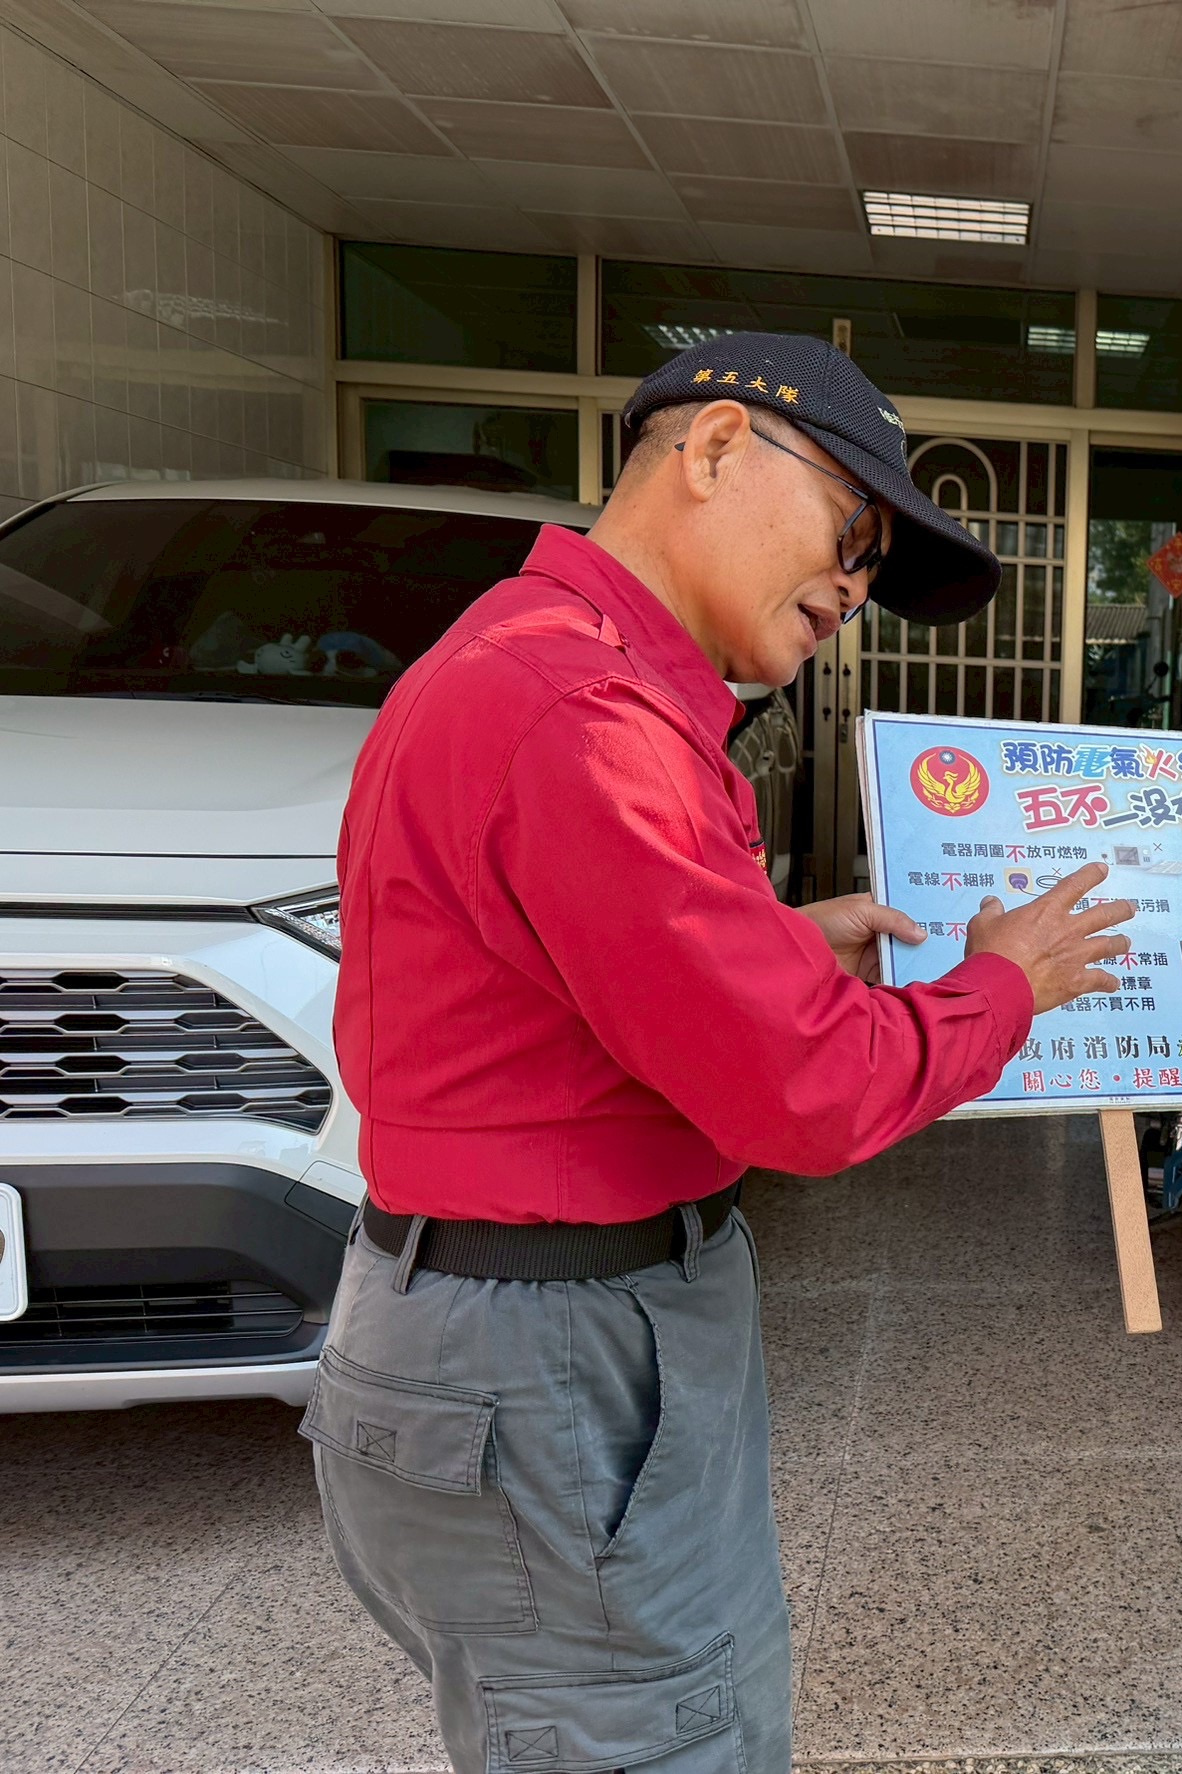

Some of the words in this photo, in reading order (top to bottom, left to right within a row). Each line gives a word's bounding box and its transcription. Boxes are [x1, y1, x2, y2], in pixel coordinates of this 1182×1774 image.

[691, 369, 799, 404] 第五大隊
[941, 842, 1088, 863] 電器周圍不放可燃物
[1092, 952, 1168, 970] 源不常插
